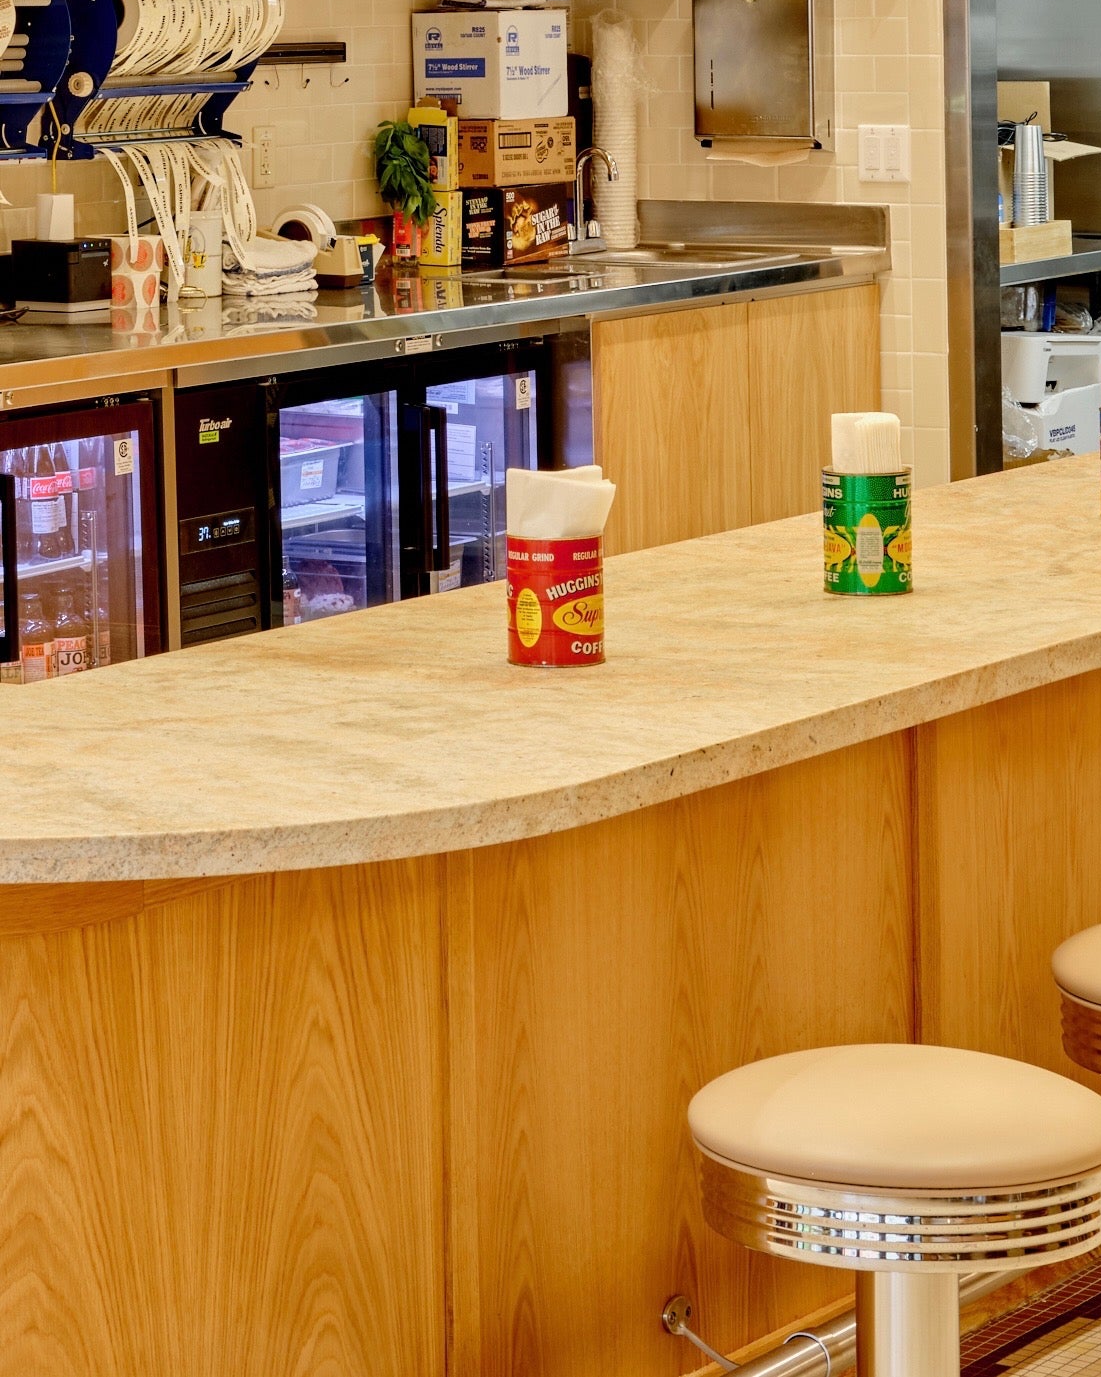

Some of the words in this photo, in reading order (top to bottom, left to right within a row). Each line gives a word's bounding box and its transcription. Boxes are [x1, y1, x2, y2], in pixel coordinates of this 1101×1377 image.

[519, 65, 533, 76] Wood
[534, 65, 550, 75] Stirrer
[531, 207, 556, 225] SUGAR
[536, 222, 545, 234] IN
[544, 215, 561, 230] THE
[434, 202, 448, 253] Splenda
[535, 230, 551, 246] RAW
[531, 552, 555, 562] GRIND
[572, 550, 598, 561] REGULAR
[546, 573, 601, 601] HUGGINS
